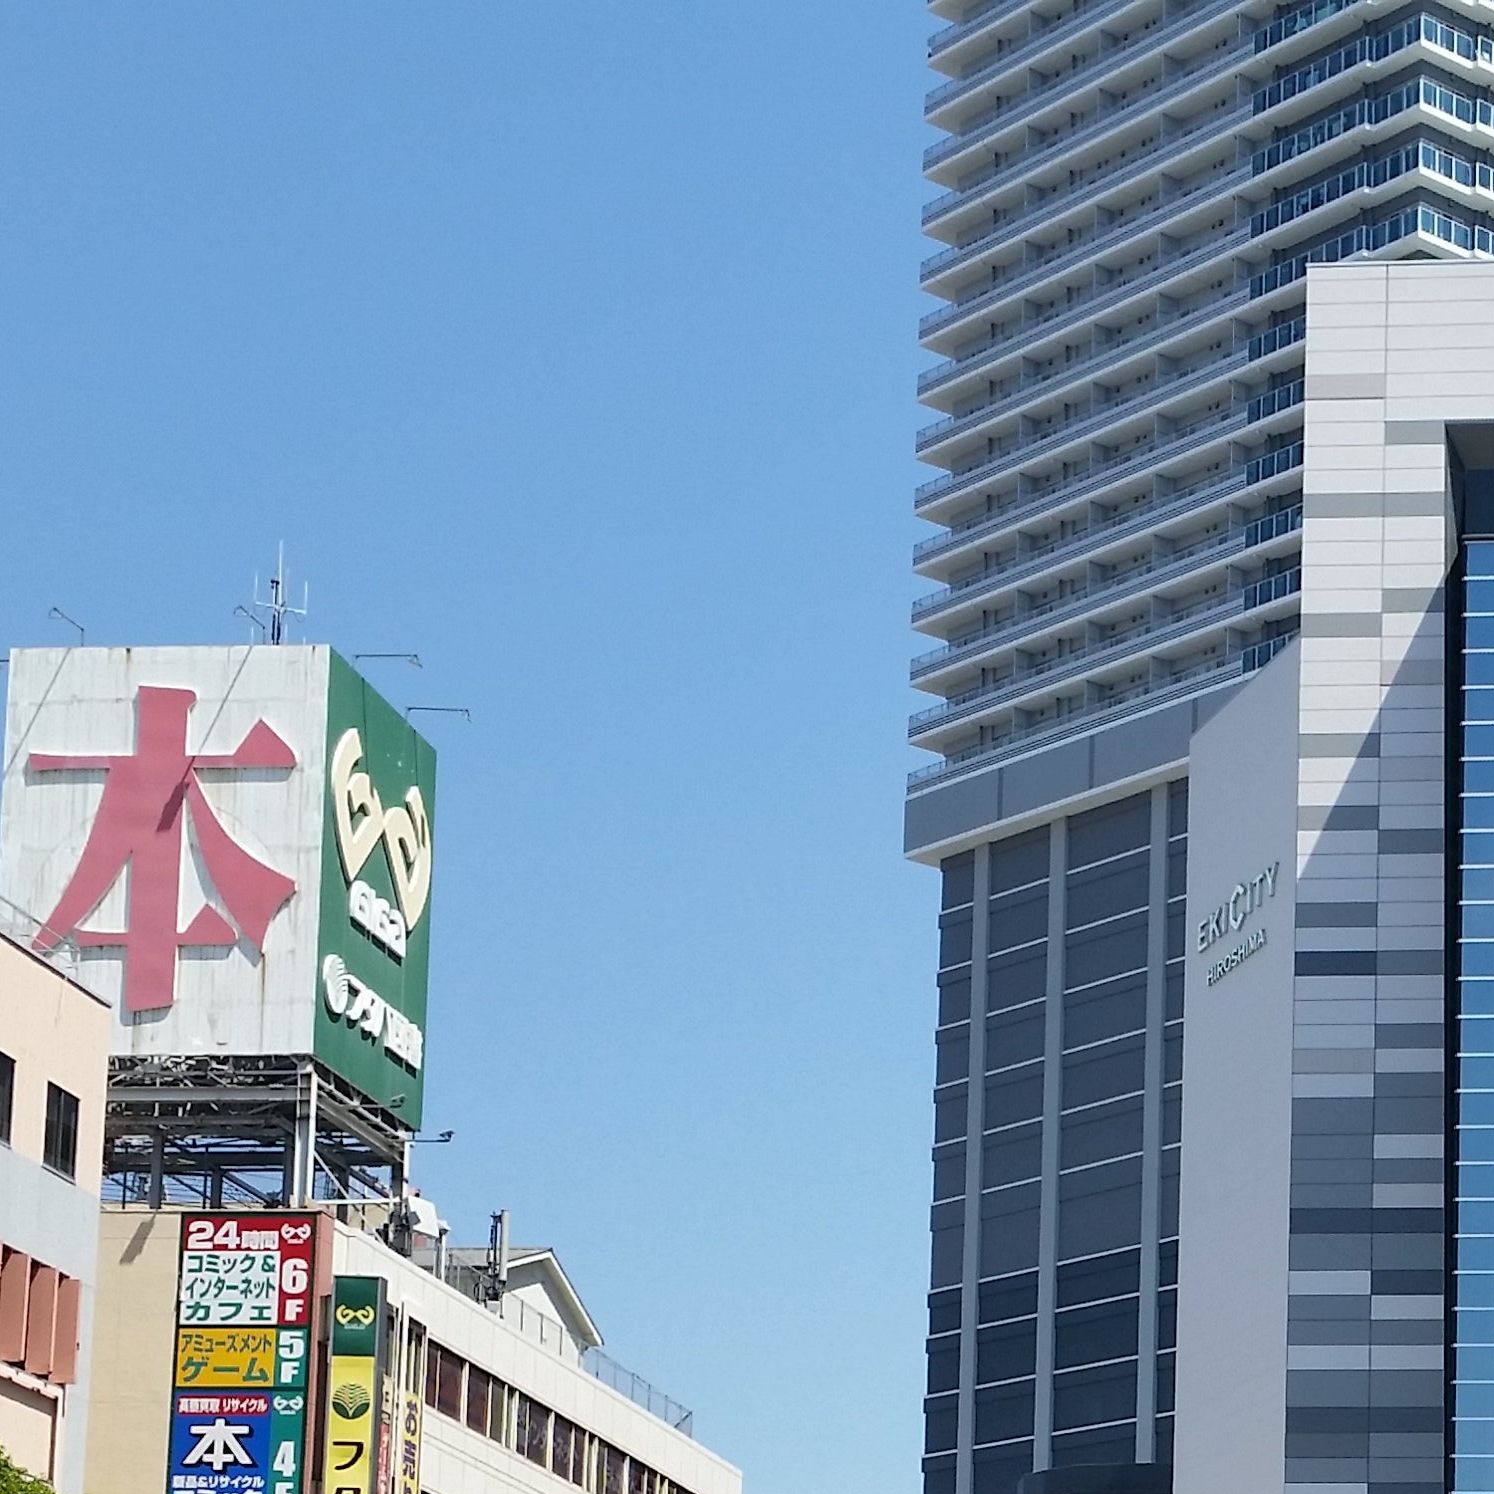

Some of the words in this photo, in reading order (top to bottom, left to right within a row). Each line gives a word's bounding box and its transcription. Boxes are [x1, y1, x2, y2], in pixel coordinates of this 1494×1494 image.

[29, 685, 297, 1010] 本
[1198, 861, 1280, 953] EKICITY
[1206, 928, 1268, 987] HIROSHIMA
[187, 1220, 280, 1250] 24時間
[187, 1254, 276, 1274] コミック&
[185, 1276, 276, 1299] インターネット
[184, 1301, 272, 1321] カフェ
[181, 1333, 272, 1353] アミューズメント
[181, 1356, 269, 1382] ゲーム
[222, 1397, 268, 1413] リサイクル
[182, 1418, 253, 1471] 本
